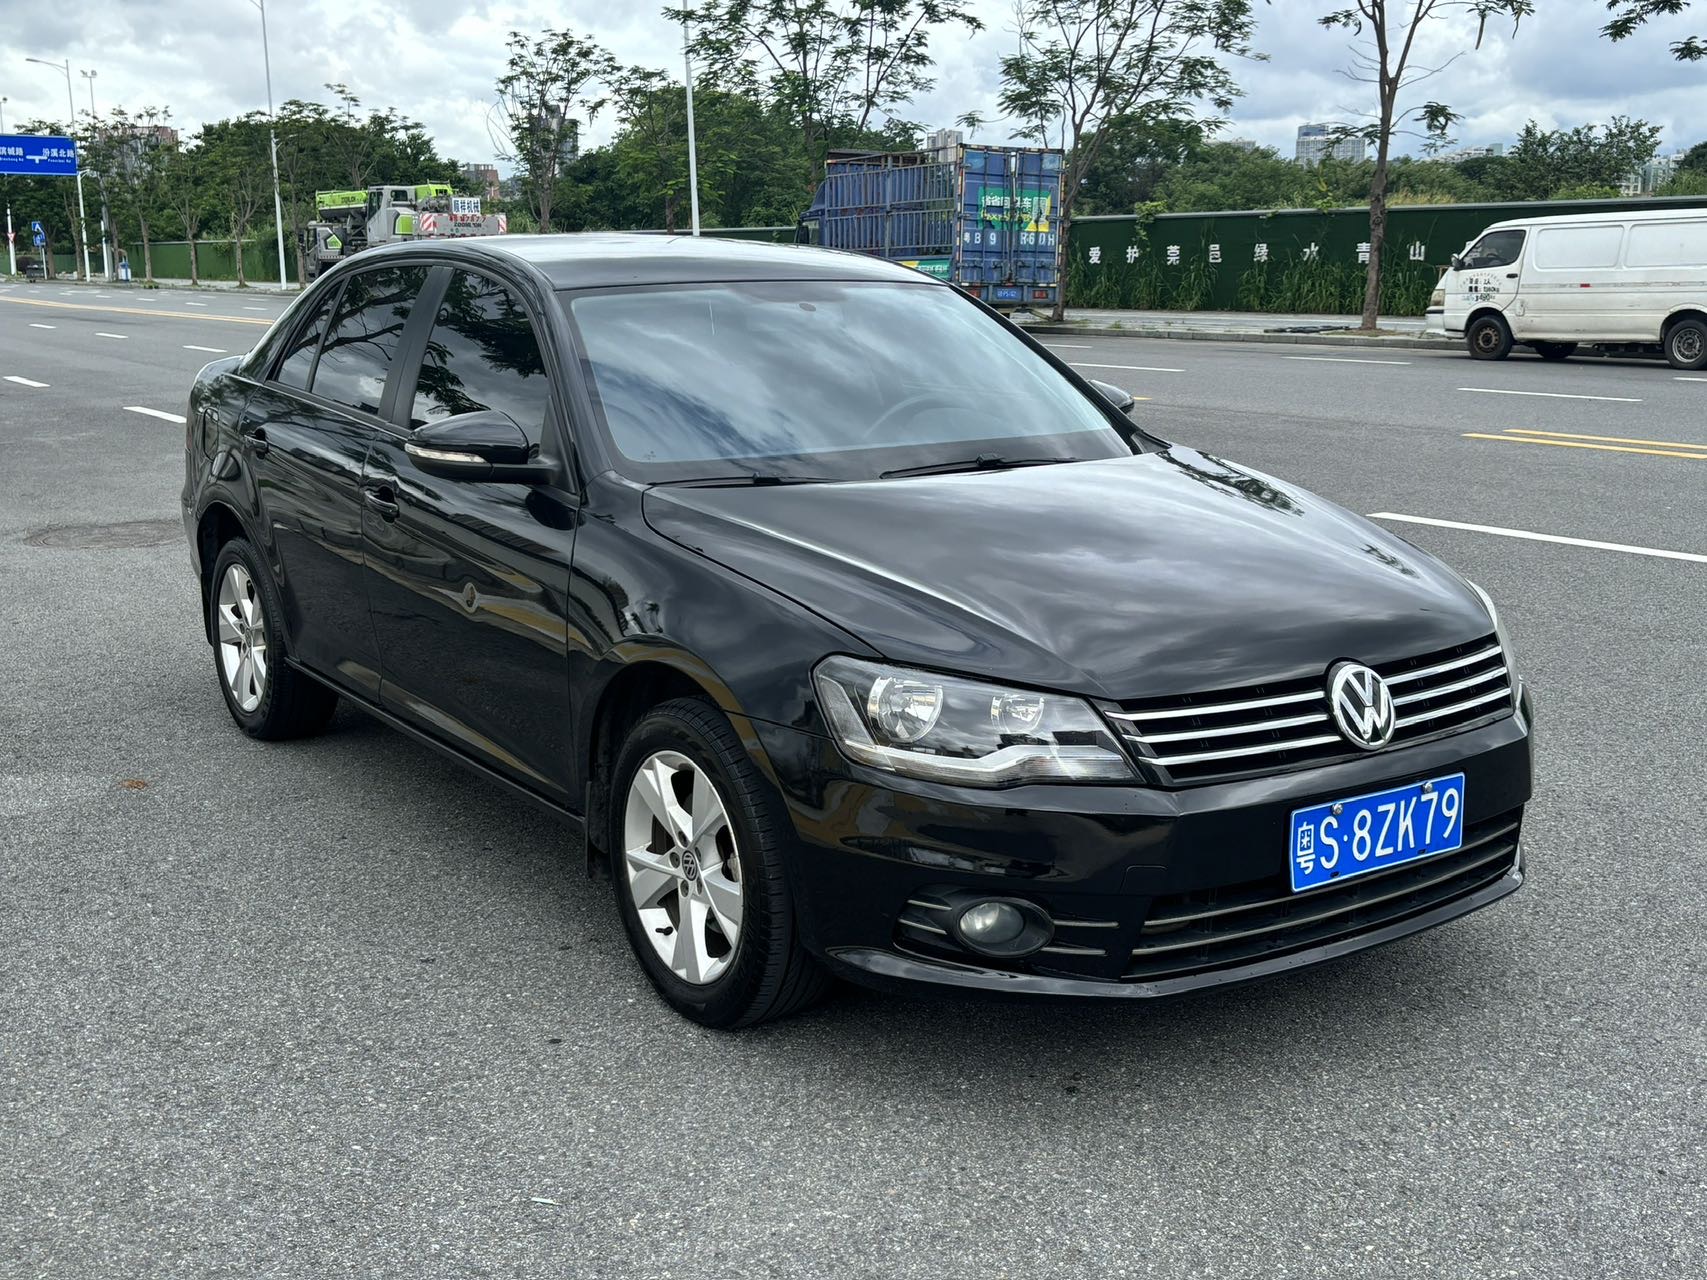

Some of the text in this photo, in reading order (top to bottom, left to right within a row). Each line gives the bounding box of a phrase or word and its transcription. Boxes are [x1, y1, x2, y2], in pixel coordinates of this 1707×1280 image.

[1089, 241, 1425, 265] 爱护莞邑绿水青山
